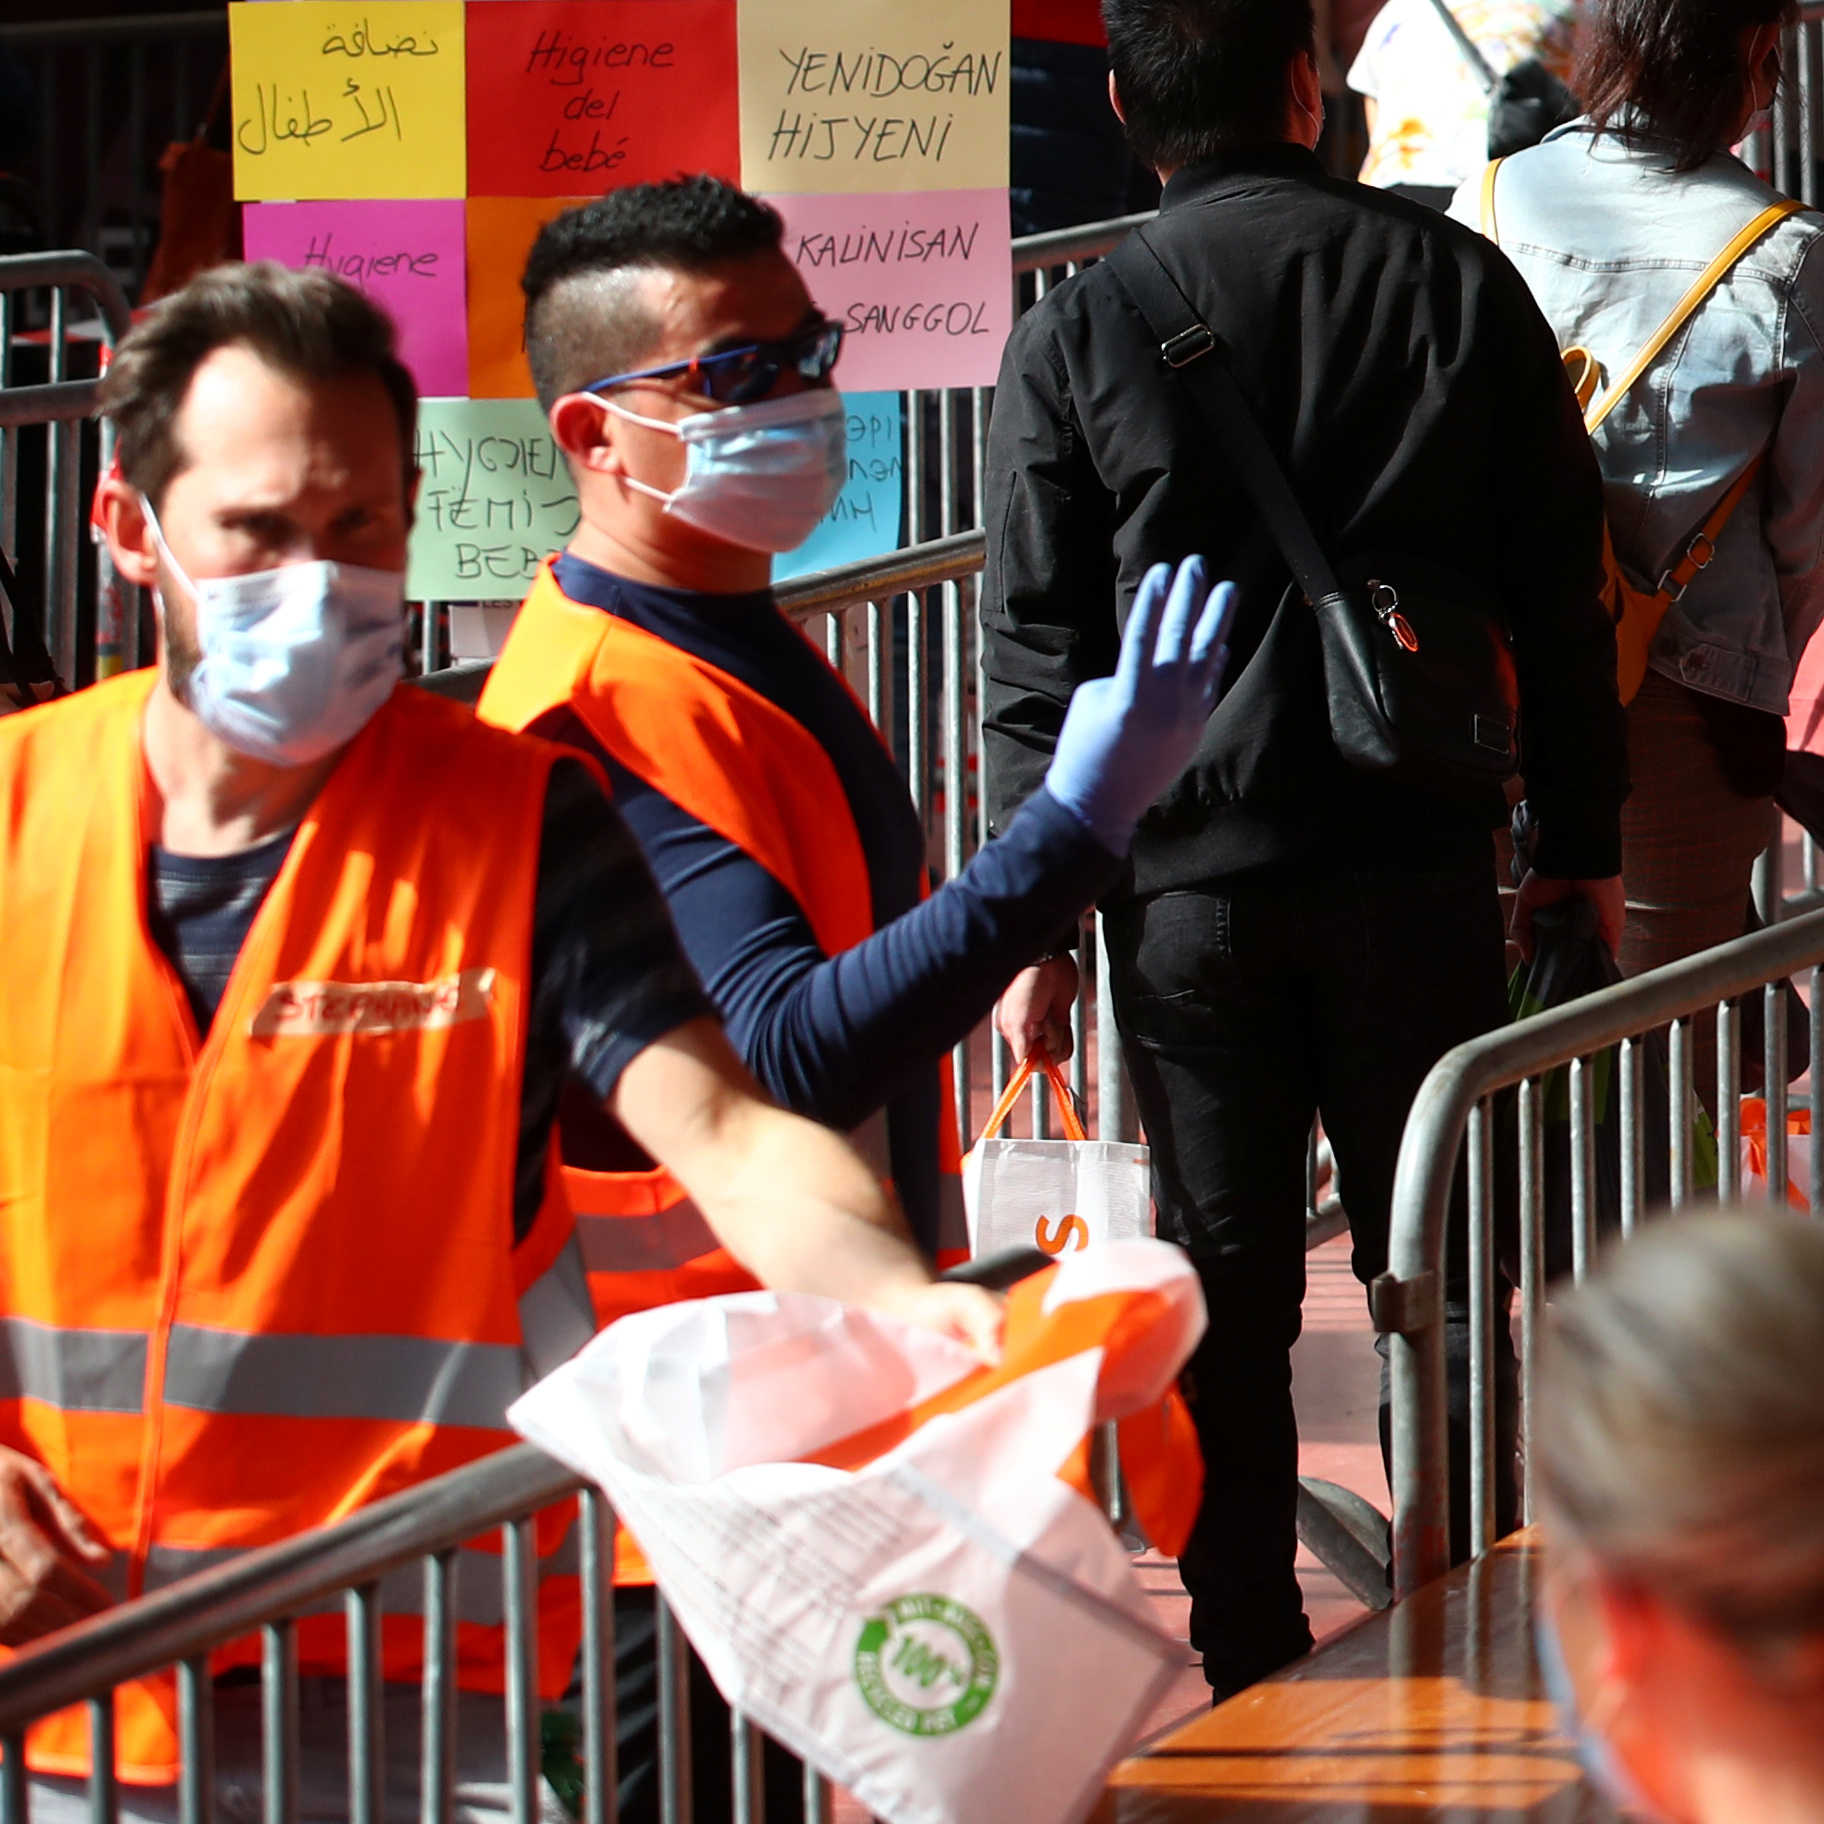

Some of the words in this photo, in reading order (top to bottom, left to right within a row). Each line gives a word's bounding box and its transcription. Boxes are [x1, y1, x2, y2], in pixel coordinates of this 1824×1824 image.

[526, 33, 675, 87] Higiene
[563, 92, 619, 123] del
[539, 129, 627, 172] bebé
